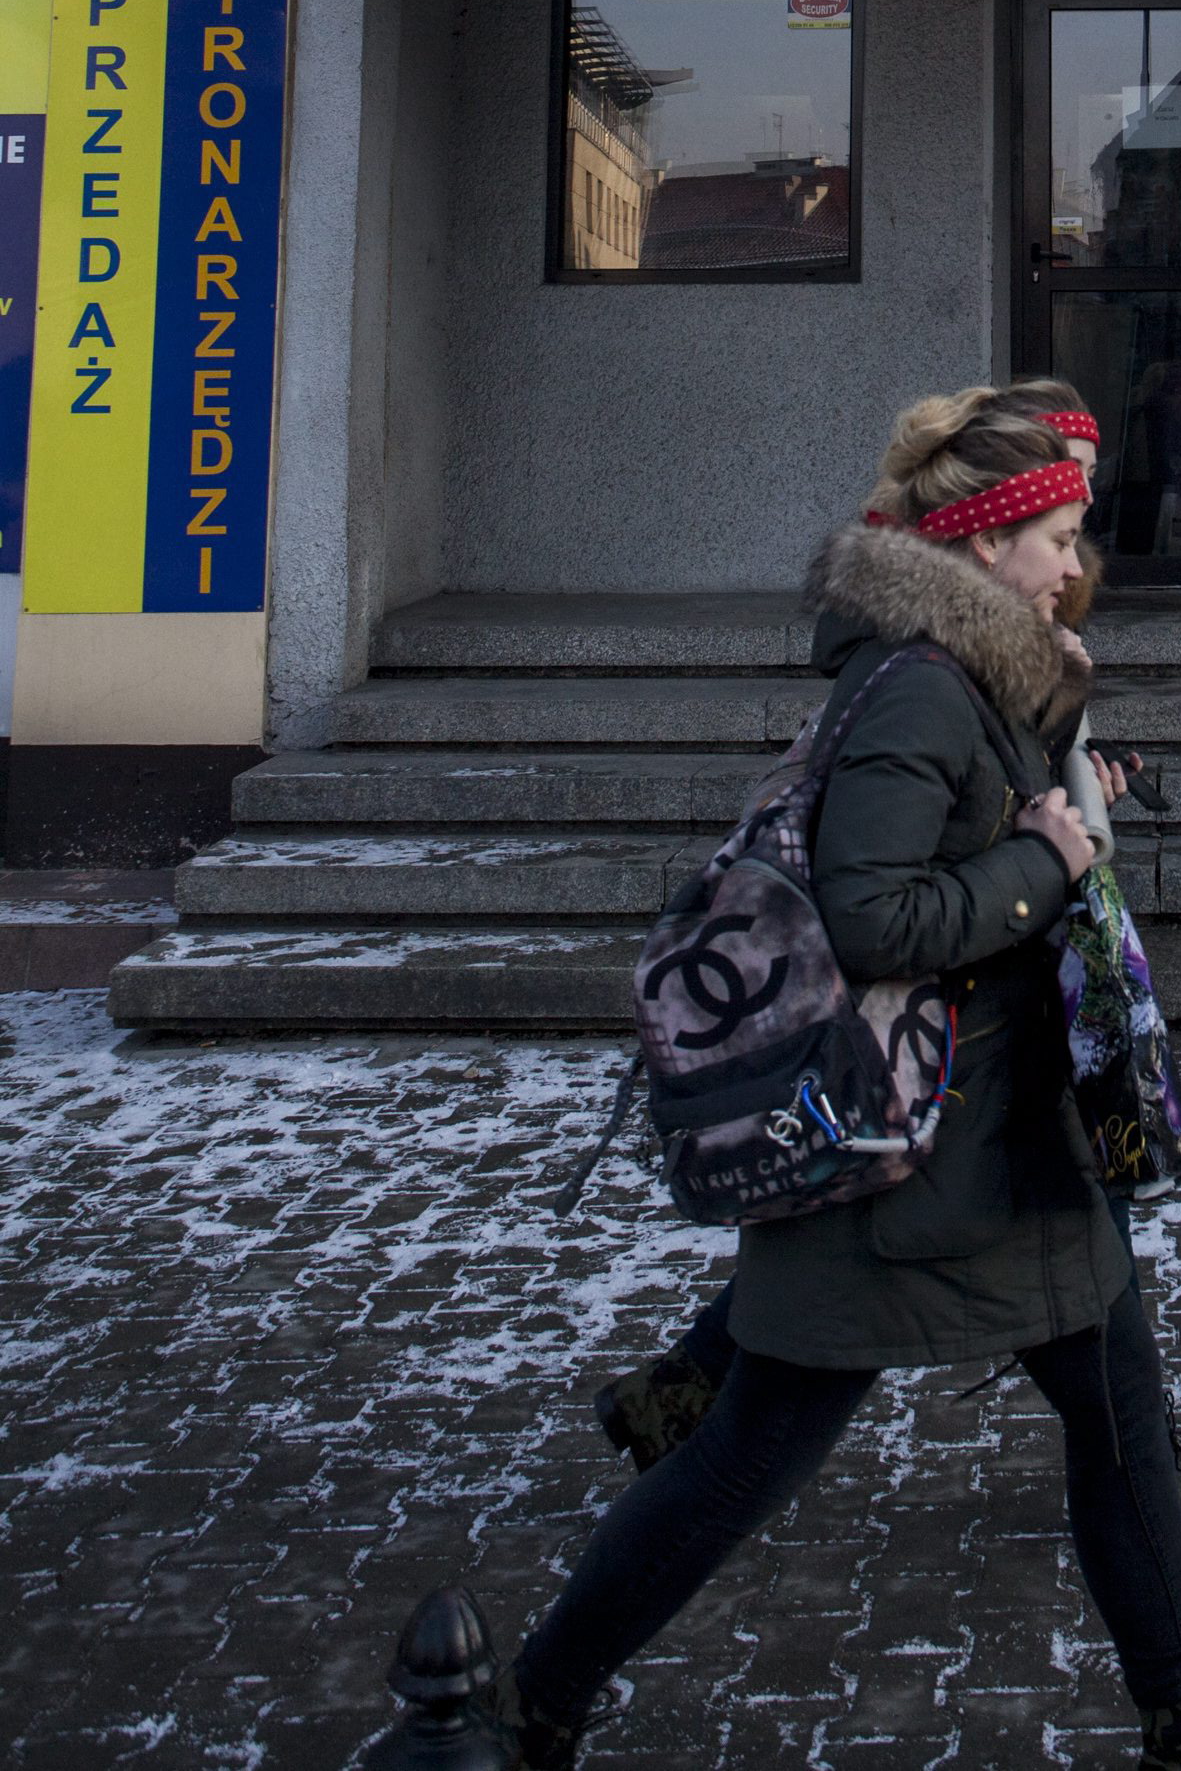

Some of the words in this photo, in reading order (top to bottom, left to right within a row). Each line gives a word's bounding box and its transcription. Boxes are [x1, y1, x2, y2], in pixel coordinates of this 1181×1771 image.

[801, 4, 838, 15] SECURITY
[709, 1167, 747, 1188] RUE
[738, 1172, 804, 1203] PARIS
